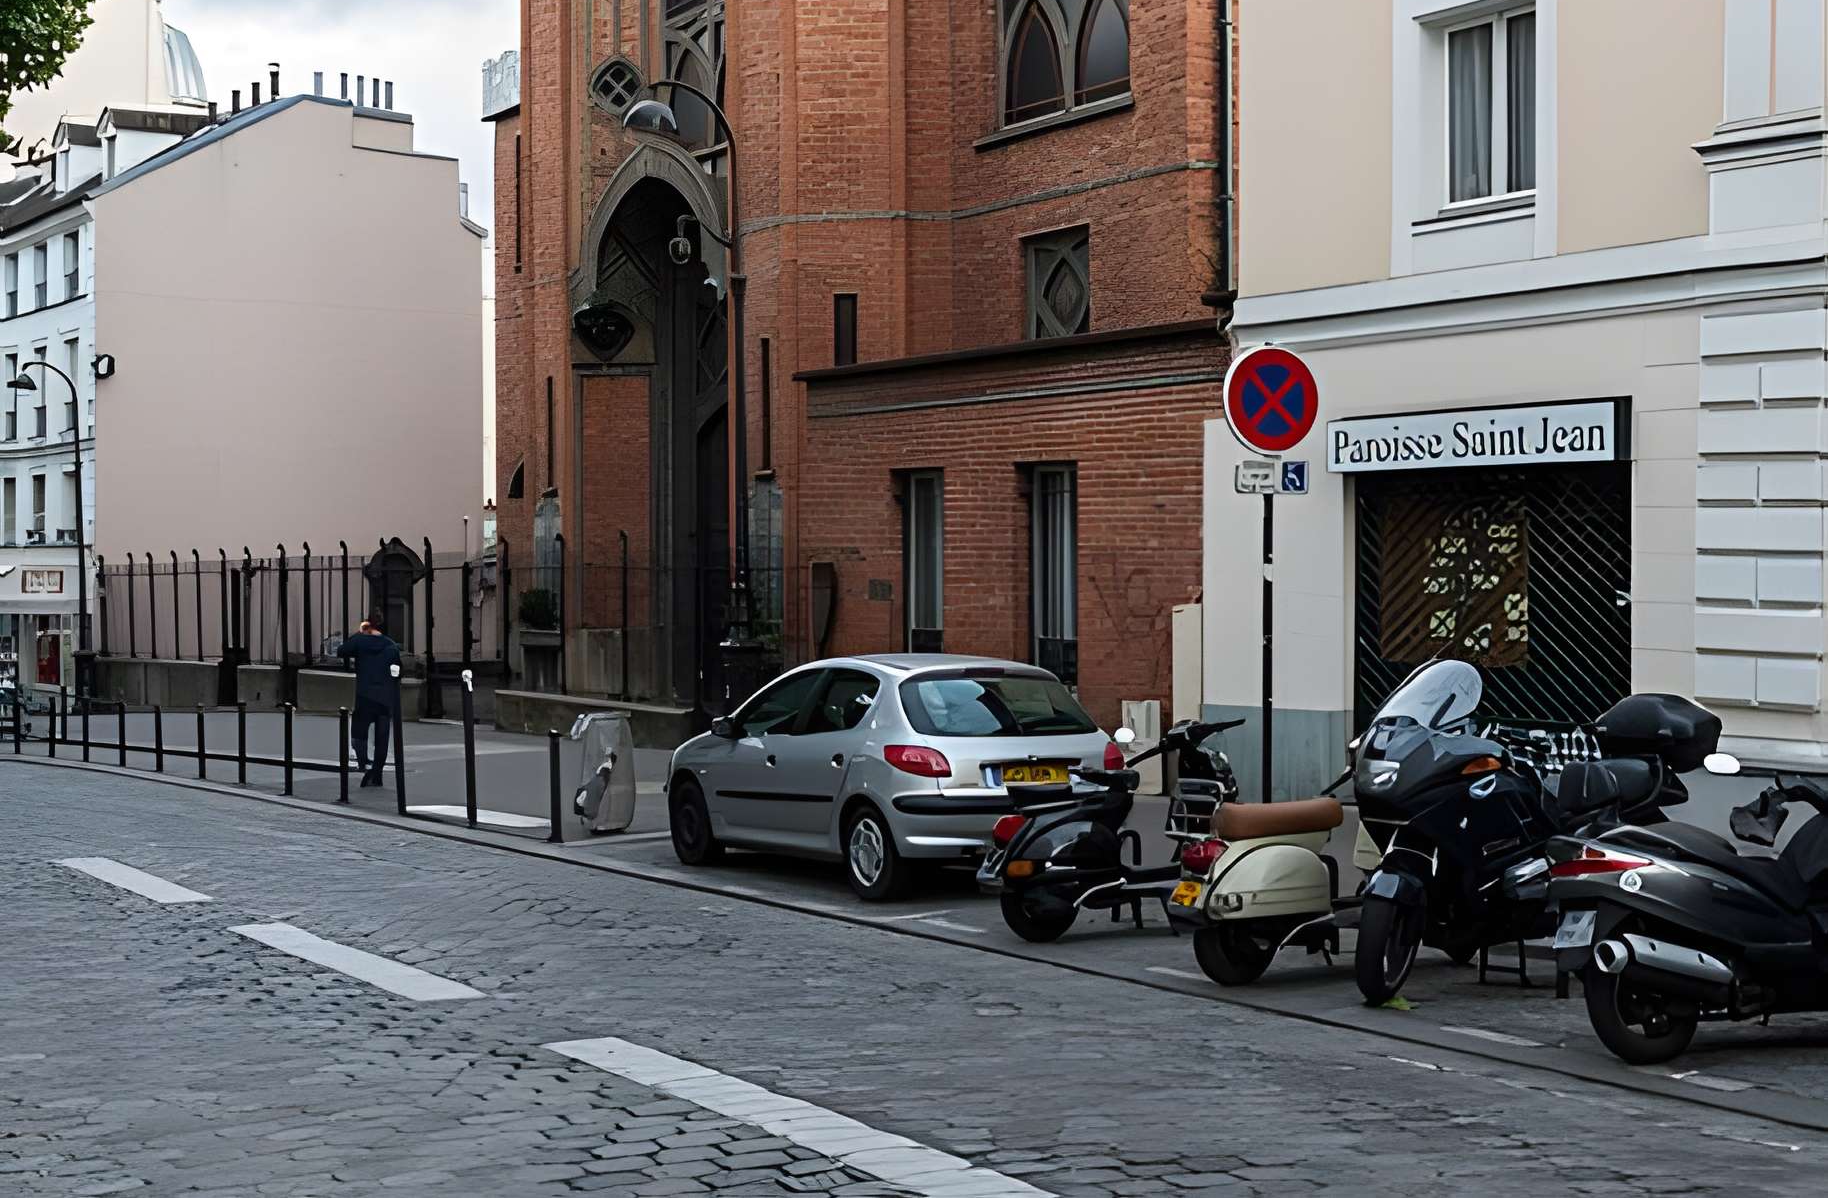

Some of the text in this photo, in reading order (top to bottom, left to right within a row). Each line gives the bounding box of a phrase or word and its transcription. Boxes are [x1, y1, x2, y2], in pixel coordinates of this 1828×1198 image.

[1334, 417, 1605, 465] Paroisse Saint Jean
